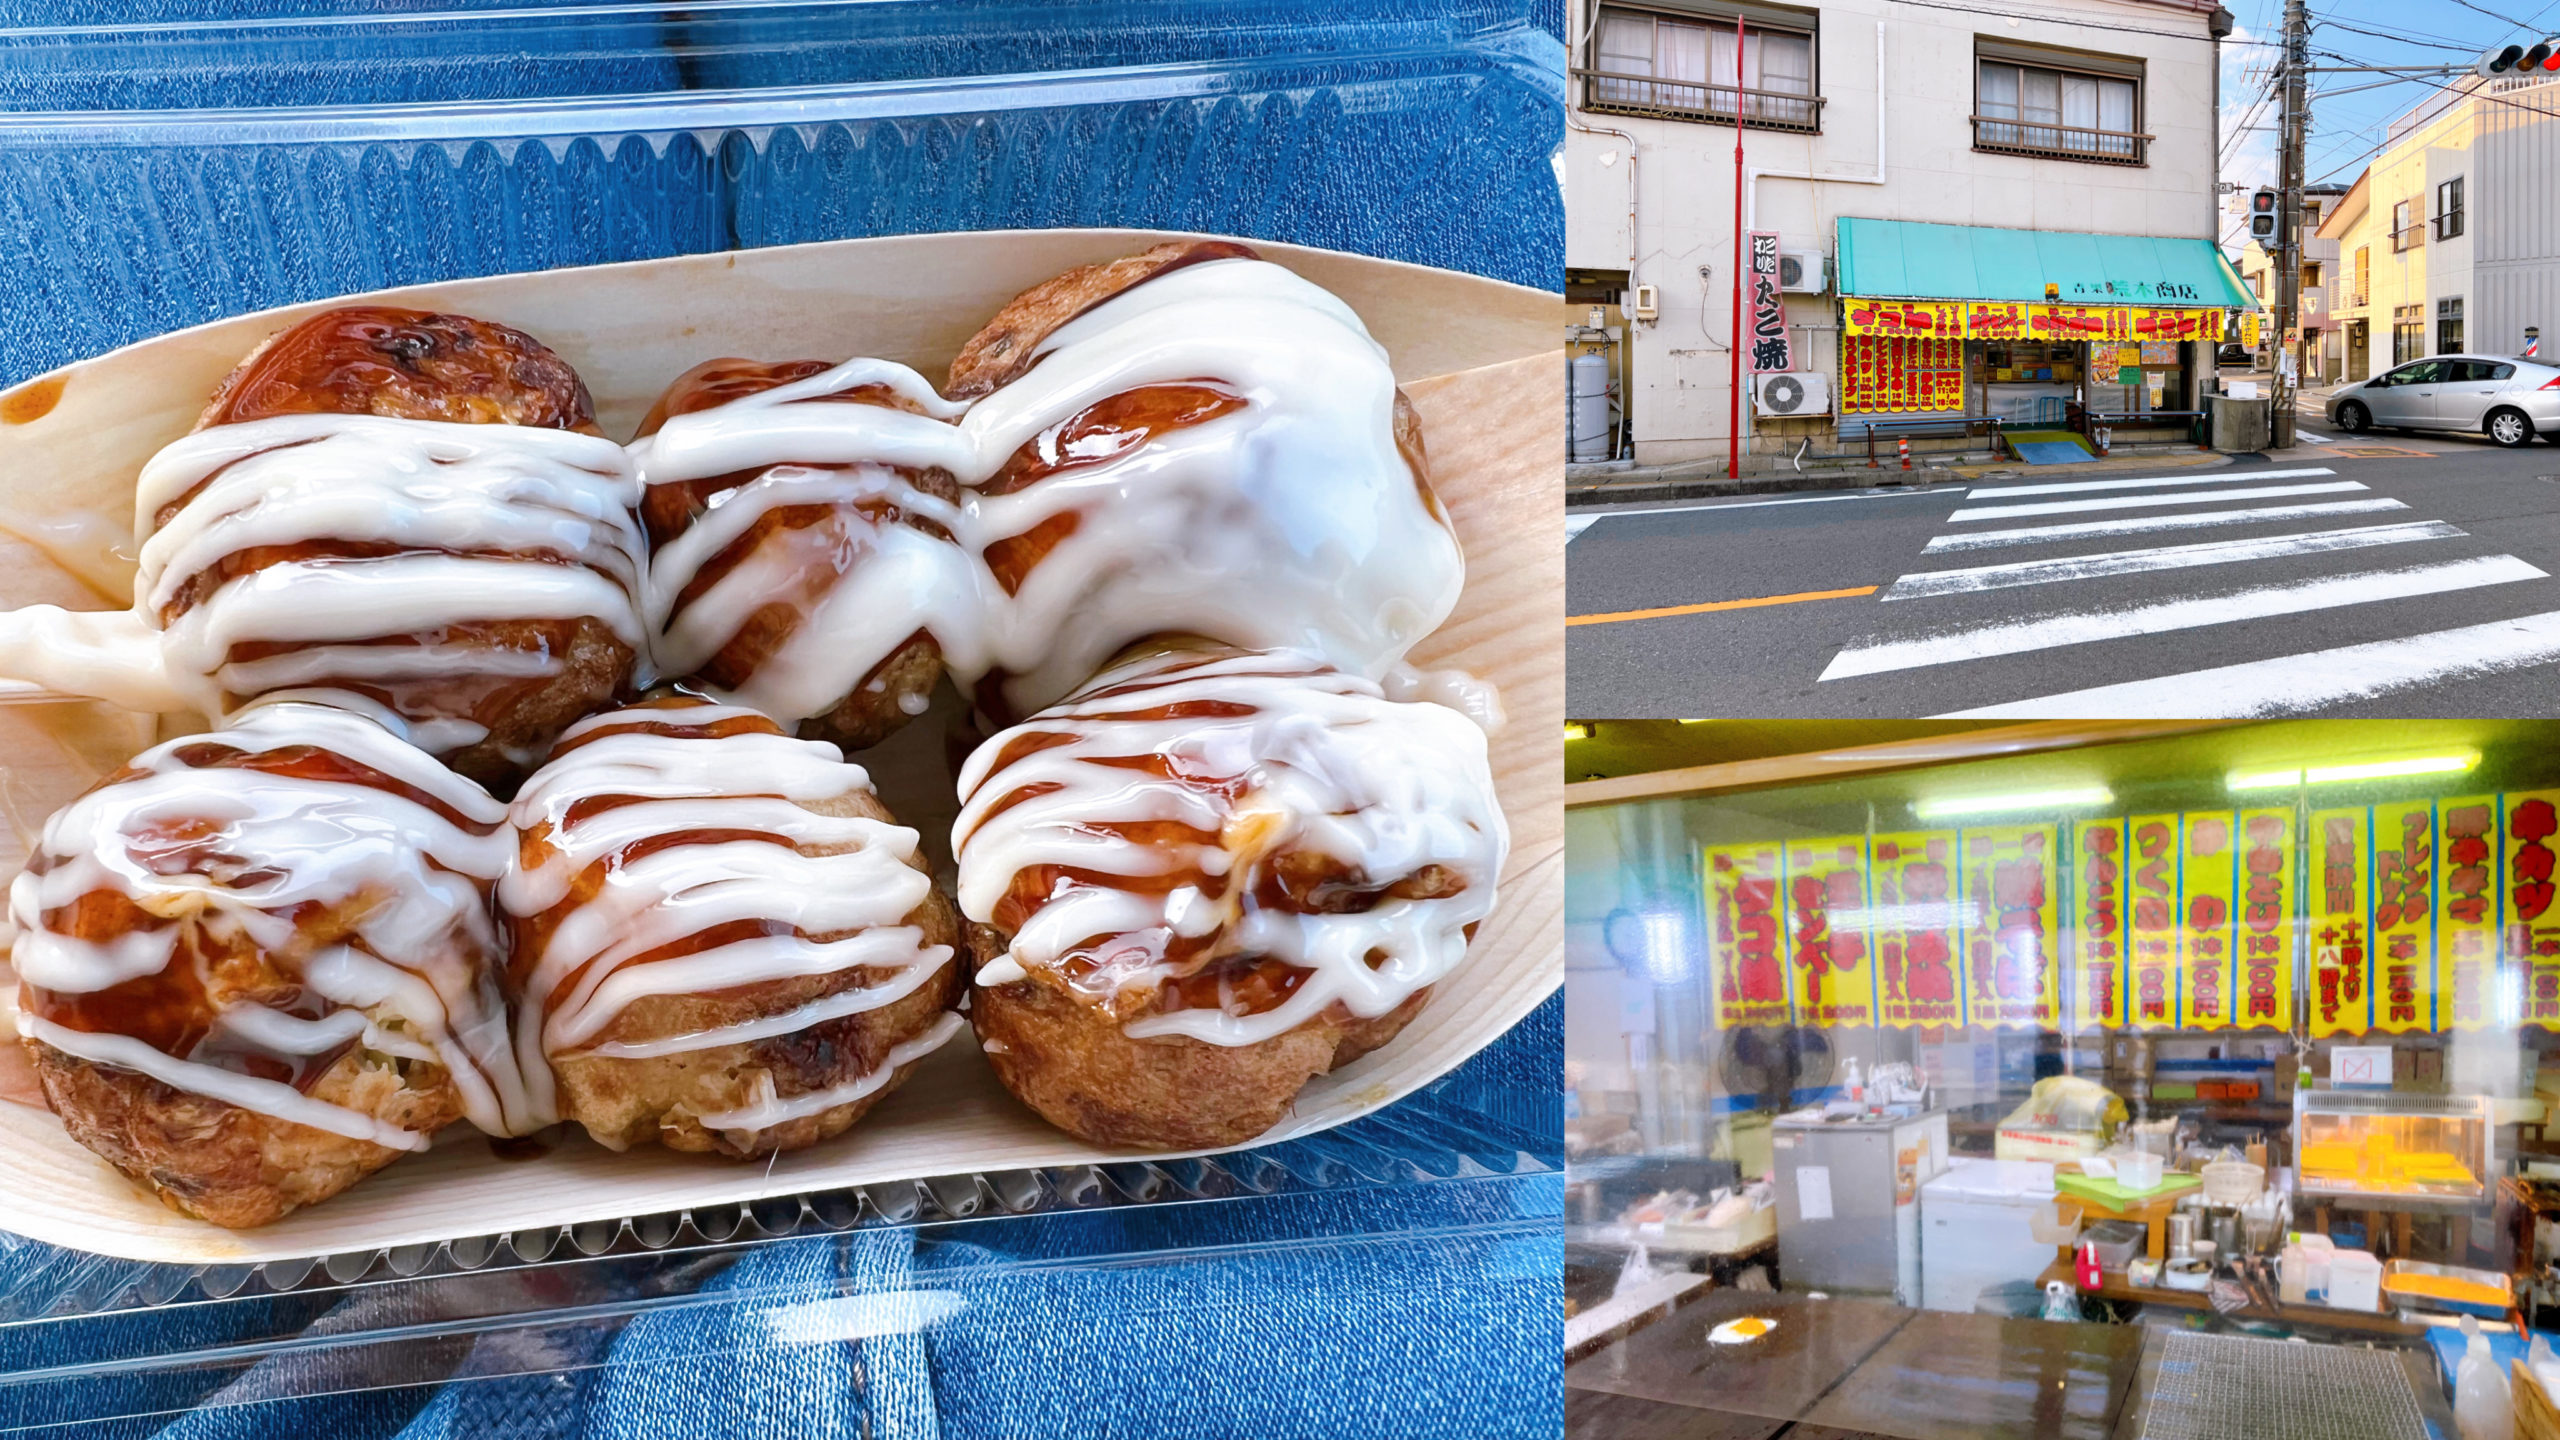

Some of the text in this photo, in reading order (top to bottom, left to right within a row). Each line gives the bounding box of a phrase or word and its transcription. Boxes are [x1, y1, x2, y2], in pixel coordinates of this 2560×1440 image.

[1753, 275, 1787, 370] たこ焼
[2135, 822, 2171, 932] つくね
